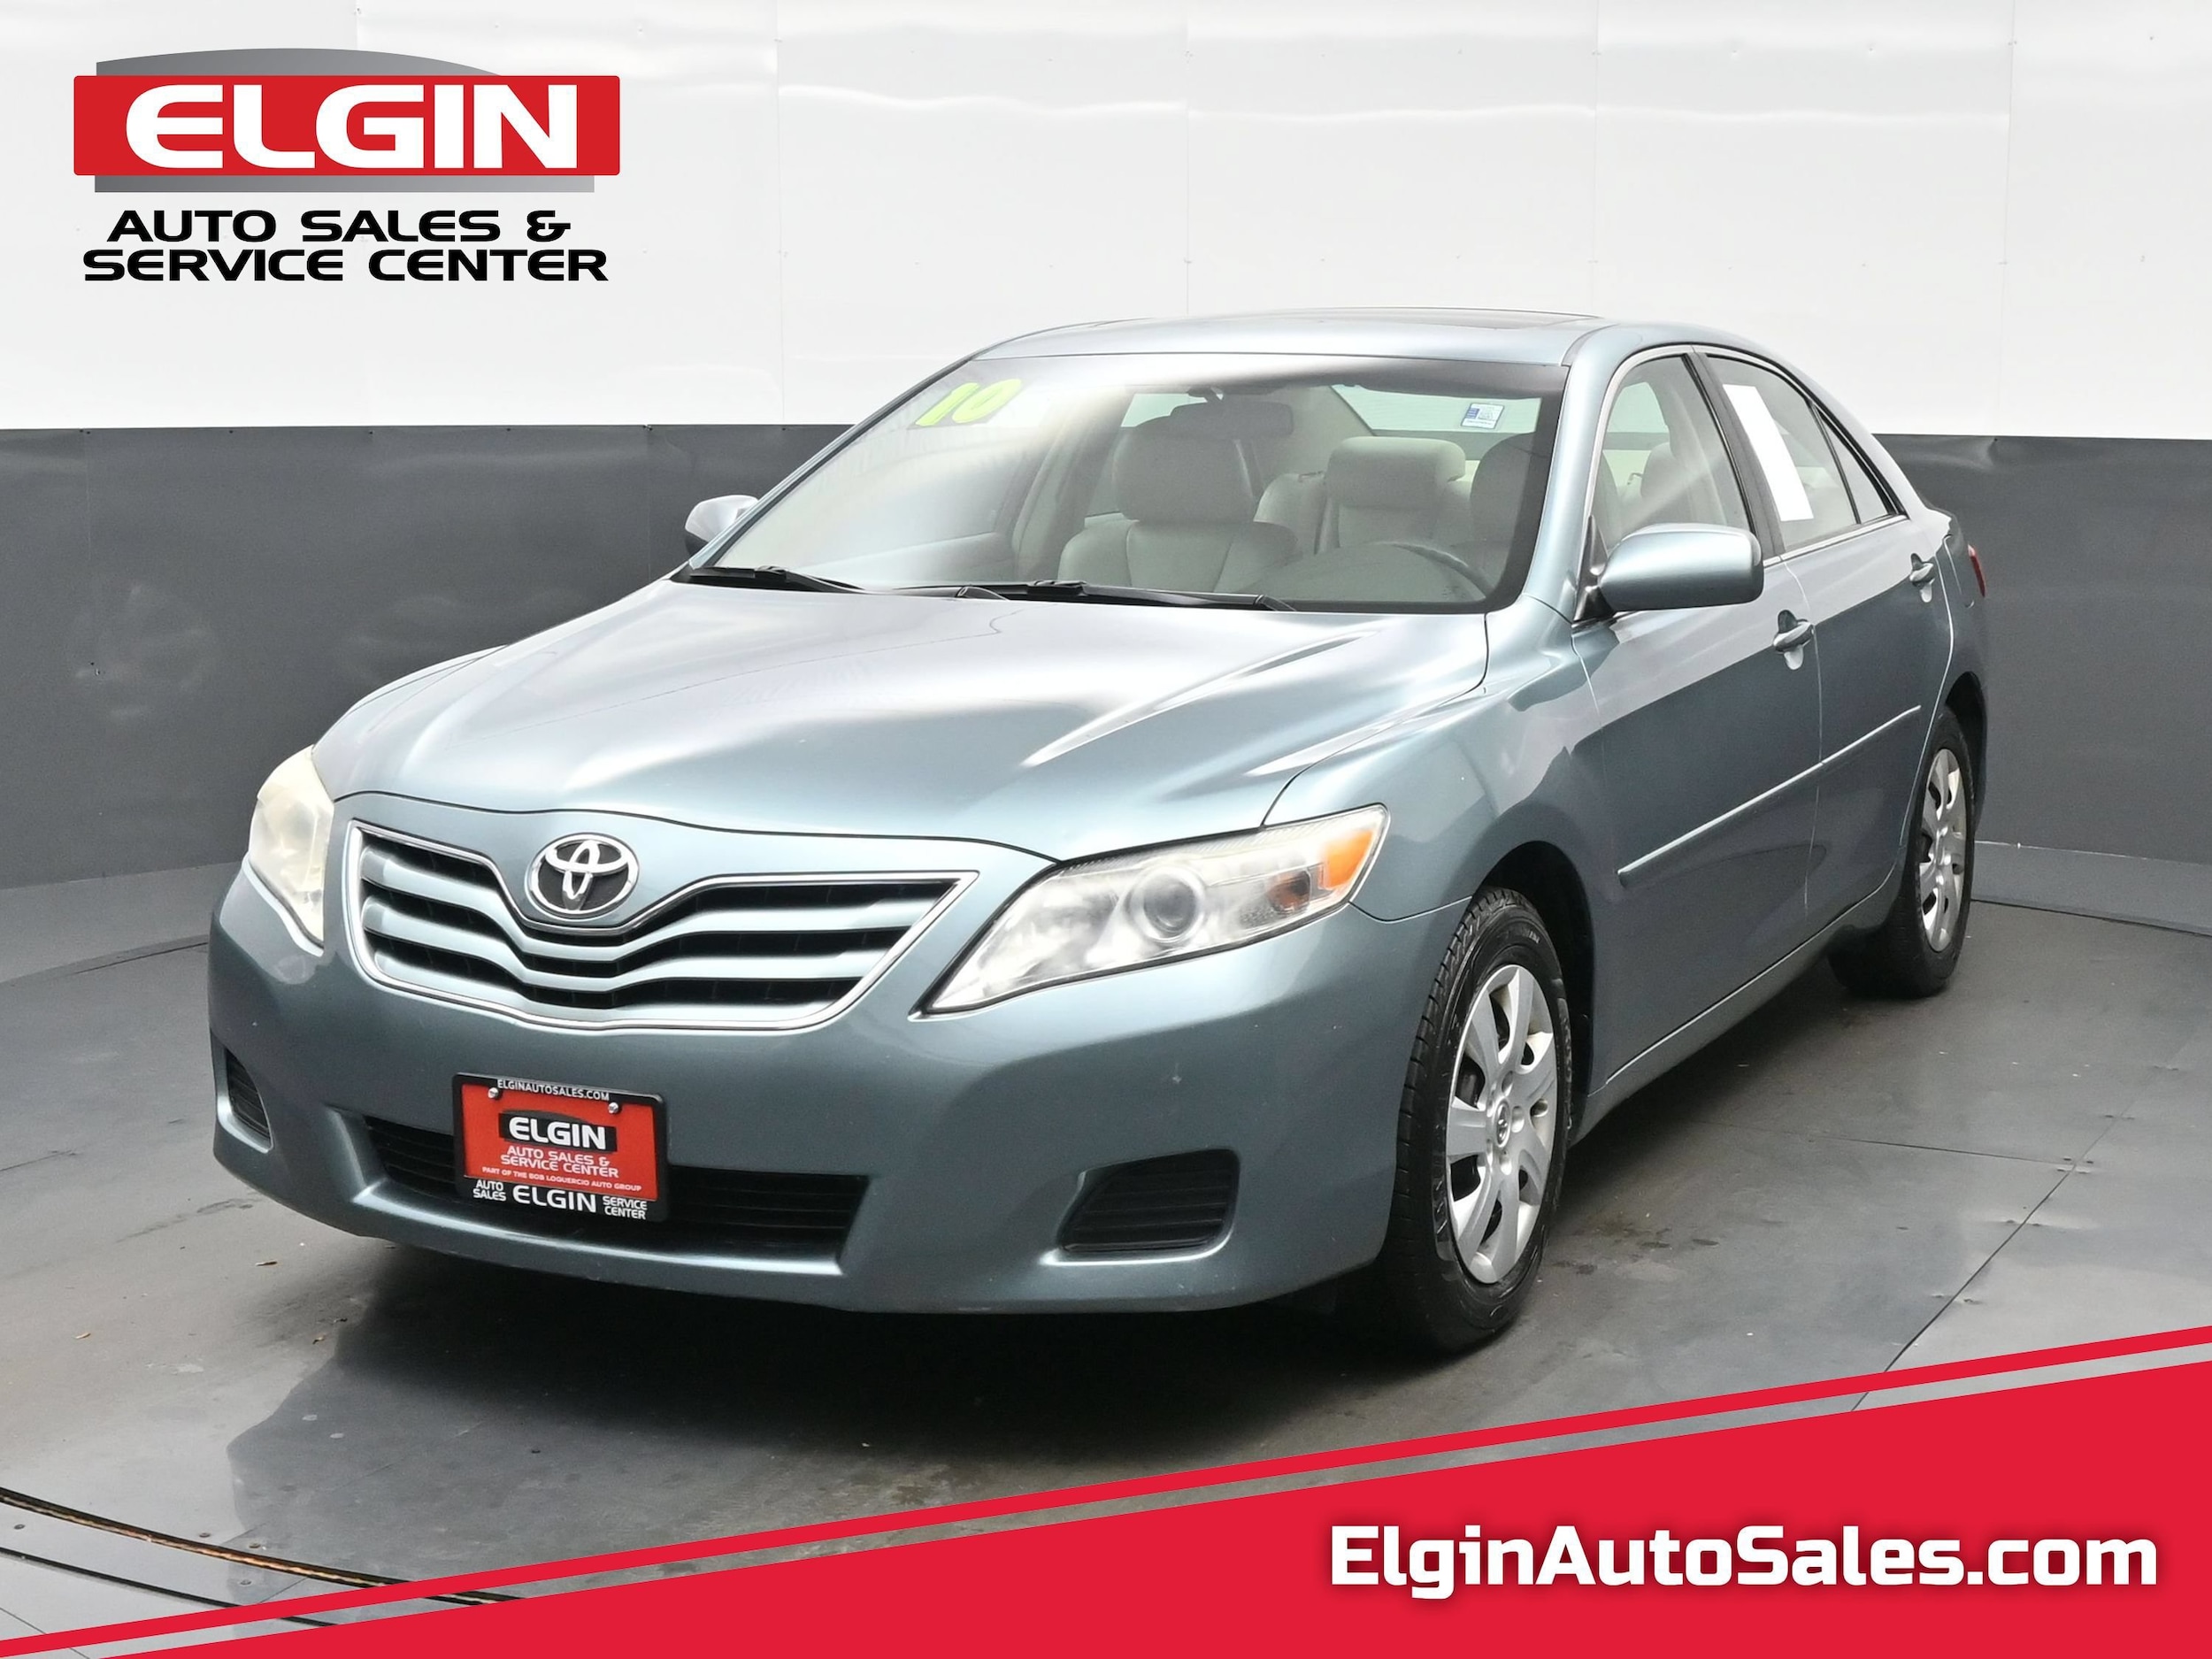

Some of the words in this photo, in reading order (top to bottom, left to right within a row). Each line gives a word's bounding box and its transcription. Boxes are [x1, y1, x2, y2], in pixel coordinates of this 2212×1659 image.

[915, 379, 1022, 426] 10
[497, 1079, 610, 1102] ELGINAUTOSALES.COM
[509, 1117, 606, 1150] ELGIN
[507, 1146, 544, 1160] AUTO
[549, 1151, 594, 1165] SALES
[599, 1156, 610, 1166] &
[482, 1166, 500, 1175] PART
[529, 1172, 544, 1181] BOB
[546, 1175, 589, 1186] LOQUERCIO
[500, 1155, 558, 1171] SERVICE
[564, 1164, 618, 1178] CENTER
[472, 1188, 506, 1202] SALES
[475, 1179, 504, 1191] AUTO
[513, 1185, 596, 1213] ELGIN
[603, 1196, 647, 1210] SERVICE
[604, 1206, 646, 1219] CENTER
